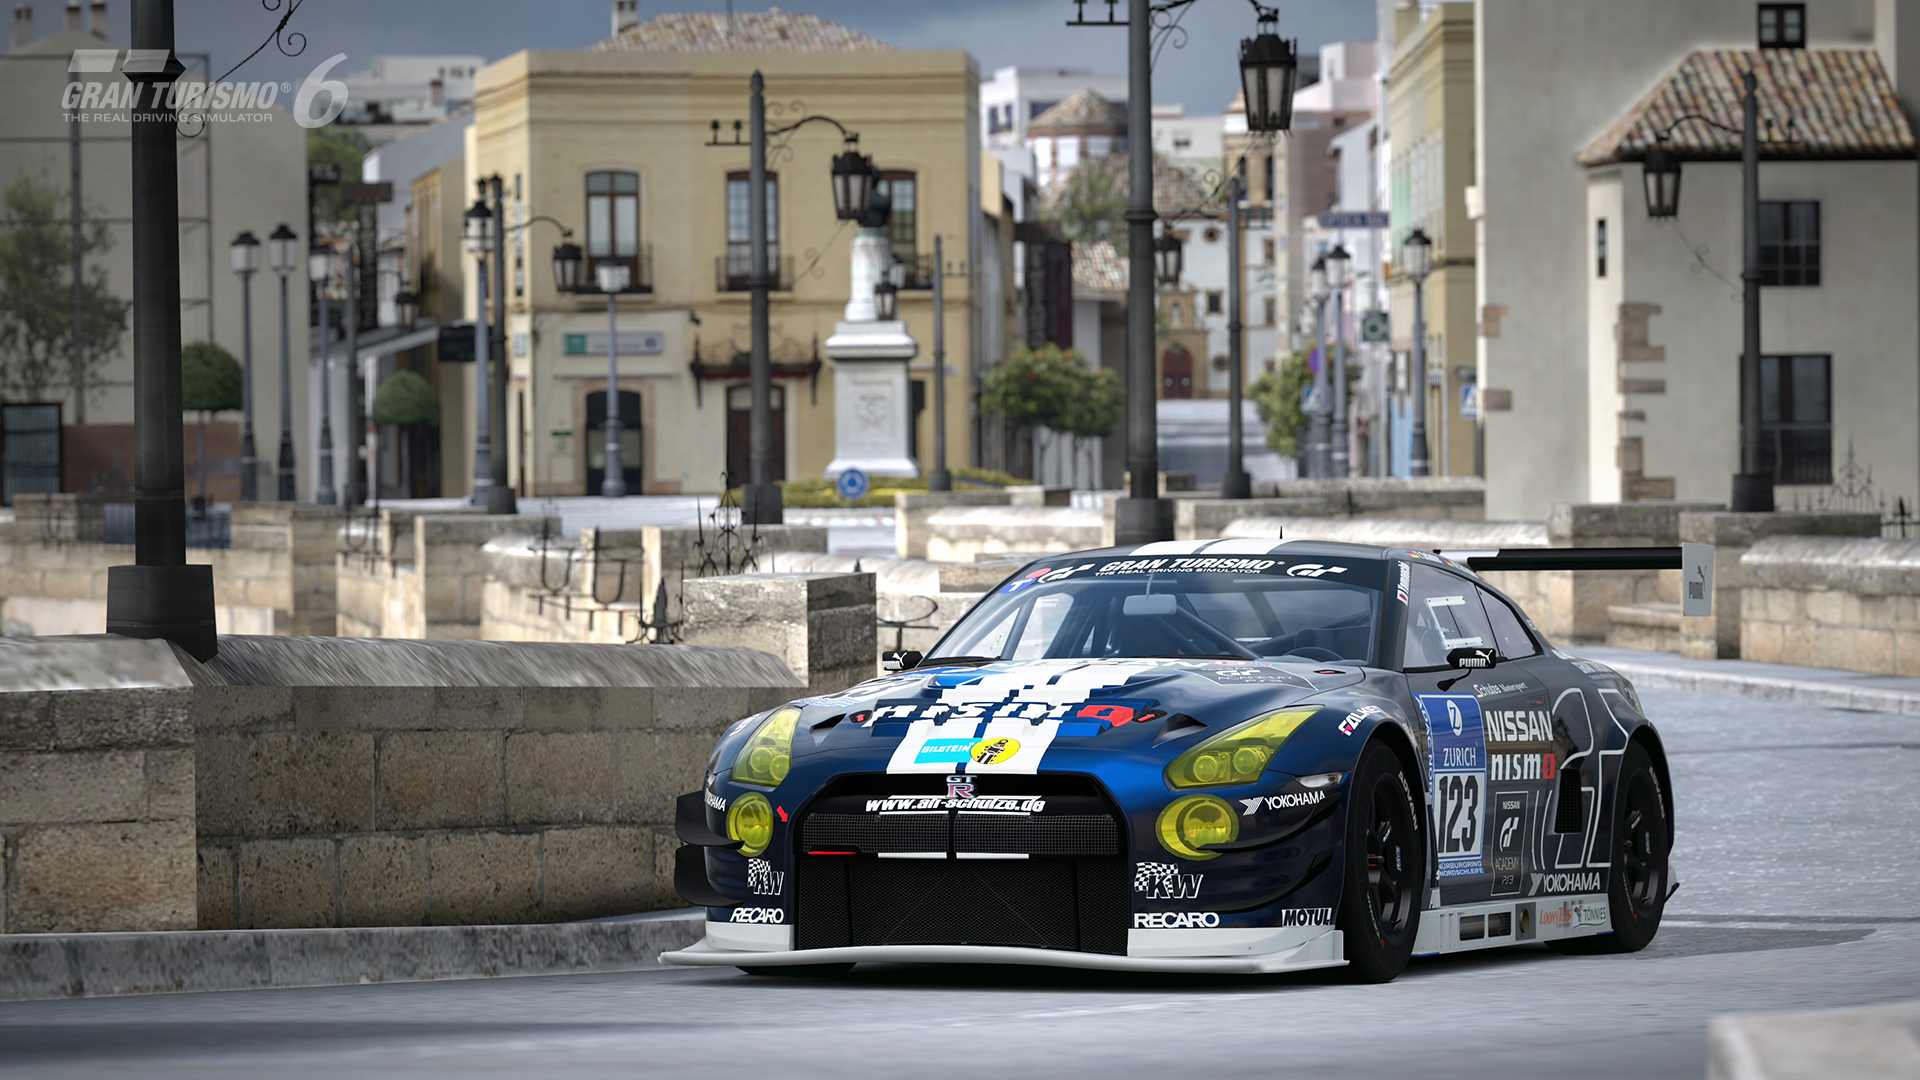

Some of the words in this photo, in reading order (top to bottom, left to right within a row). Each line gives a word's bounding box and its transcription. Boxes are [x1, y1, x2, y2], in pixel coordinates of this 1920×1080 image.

[1099, 558, 1169, 573] GRAN
[1459, 658, 1486, 667] PUMA
[1473, 682, 1502, 698] Schulze
[1485, 710, 1554, 742] NISSAN
[1443, 747, 1476, 767] ZURICH
[1491, 753, 1555, 780] nismo
[946, 775, 977, 783] GT
[946, 783, 976, 798] R
[1264, 790, 1326, 810] YOKOHAMA
[1398, 771, 1419, 830] ADVAN
[1502, 801, 1520, 810] NISSAN
[1438, 775, 1478, 853] 123
[1495, 857, 1520, 870] ACADEMY
[753, 870, 785, 896] KW
[1146, 873, 1203, 898] KW
[1543, 872, 1600, 893] YOKOHAMA
[729, 908, 785, 924] RECARO
[1134, 912, 1220, 928] RECARO
[1283, 908, 1331, 926] MOTUL
